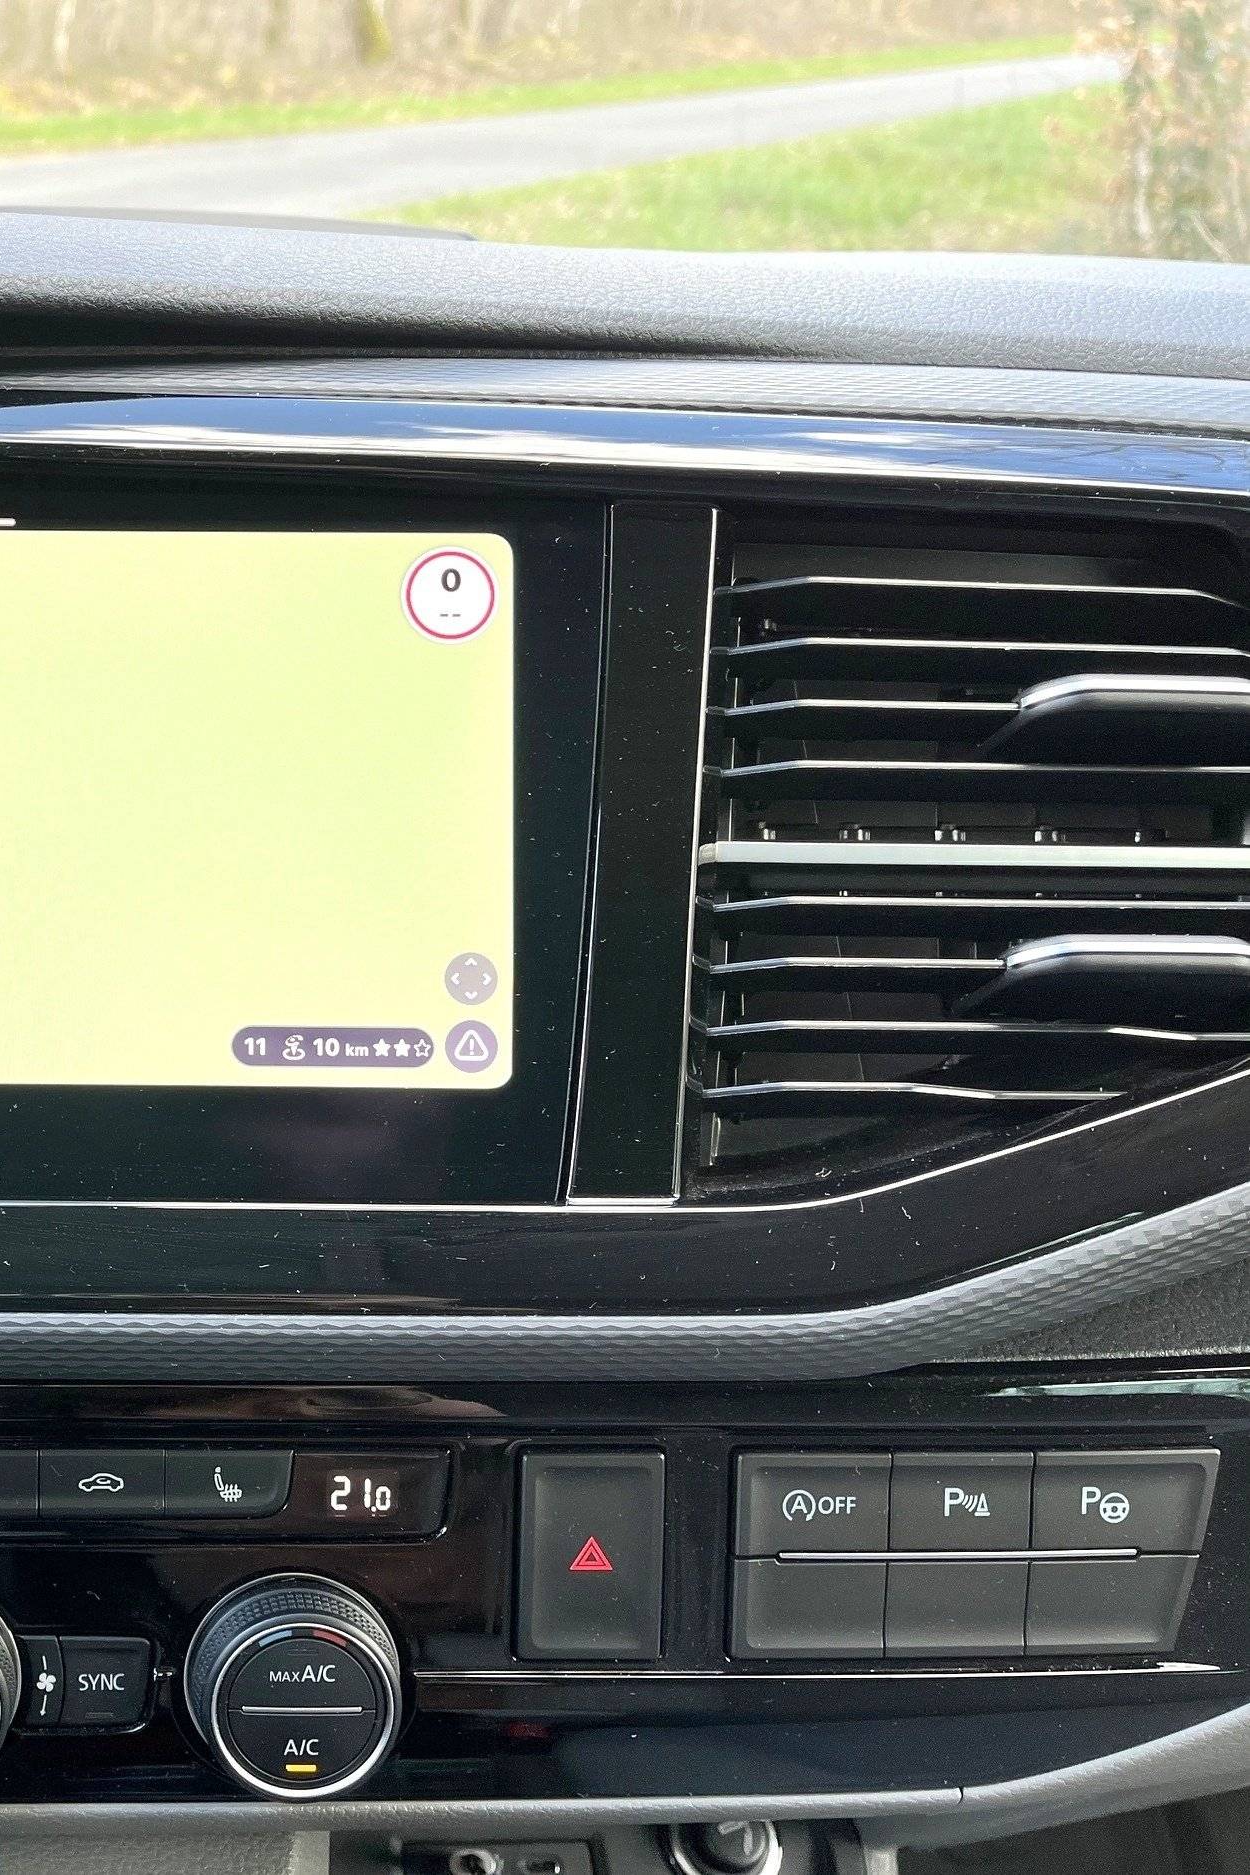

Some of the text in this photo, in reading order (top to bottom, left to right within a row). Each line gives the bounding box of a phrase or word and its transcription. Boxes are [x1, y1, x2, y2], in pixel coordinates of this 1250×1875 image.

[441, 568, 461, 592] 0
[244, 1037, 369, 1057] 11 10 km
[818, 1496, 856, 1515] OFF
[78, 1672, 125, 1692] SYNC
[283, 1738, 319, 1757] A/C
